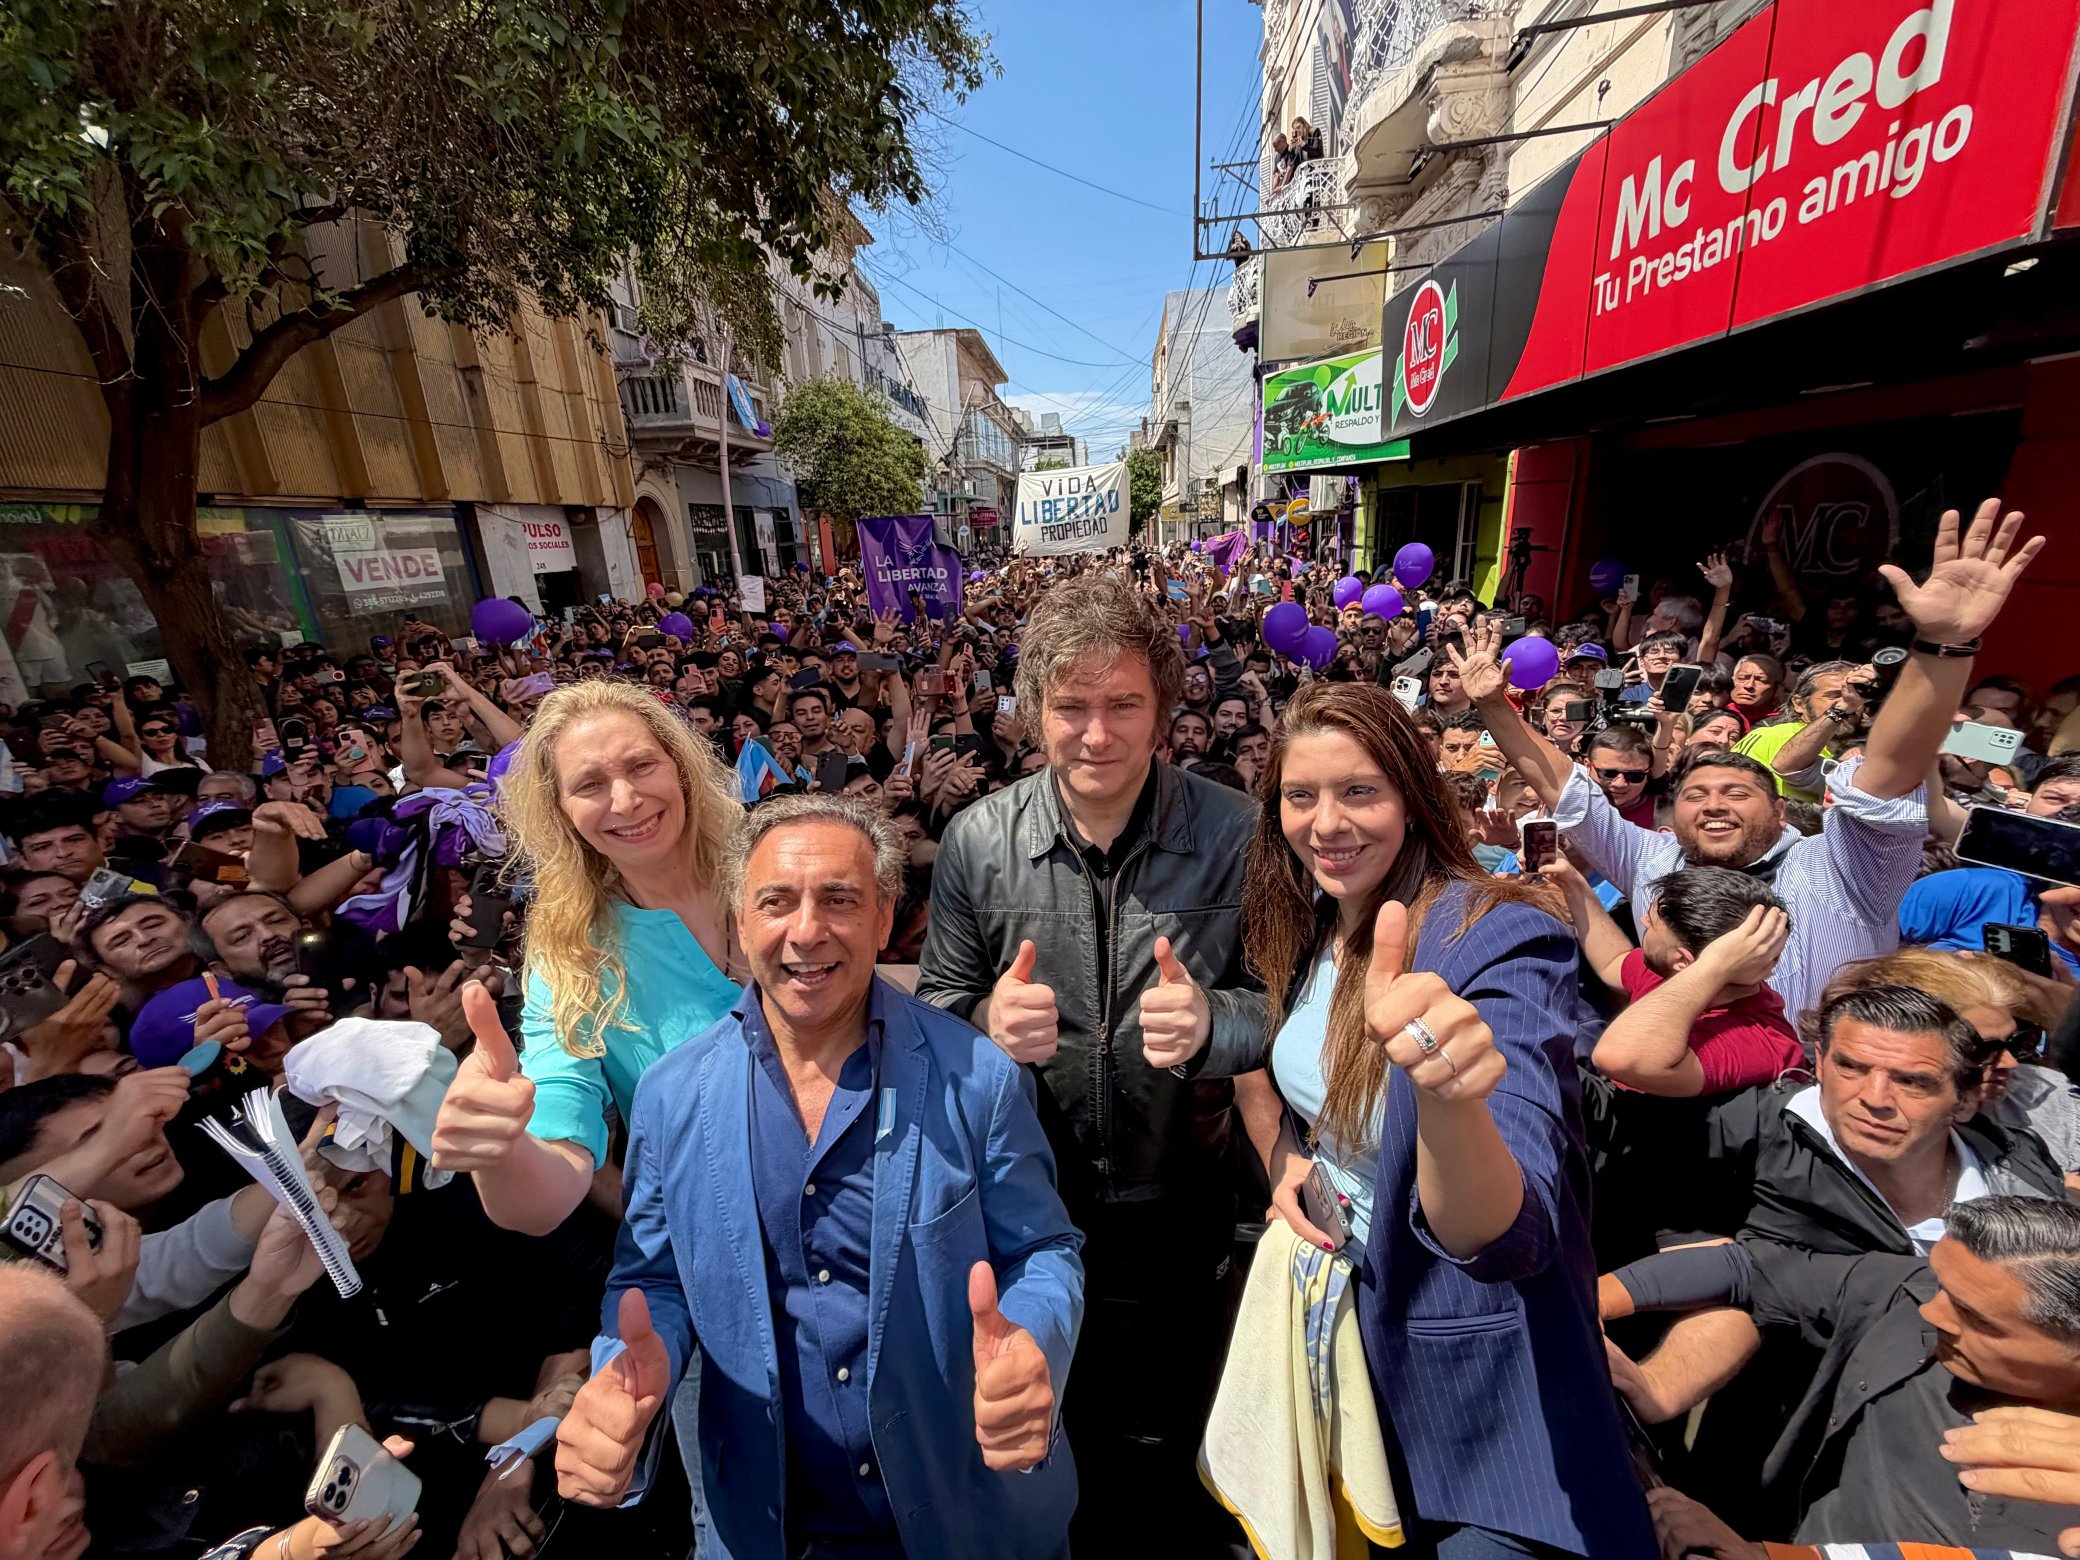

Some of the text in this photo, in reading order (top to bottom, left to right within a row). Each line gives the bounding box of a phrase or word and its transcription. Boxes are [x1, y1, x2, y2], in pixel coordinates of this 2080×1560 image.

[1609, 0, 1954, 261] Mc Cred
[1594, 104, 1973, 316] Tu Prestamo amigo
[1335, 414, 1380, 430] RESPALDO Y
[1021, 489, 1120, 525] LIBERTAD
[1041, 517, 1108, 543] PROPIEDAD
[539, 541, 570, 550] SOCIALES
[343, 554, 439, 583] VENDE
[875, 555, 894, 567] LA
[878, 568, 948, 582] LIBERTAD
[908, 583, 948, 593] AVANZA
